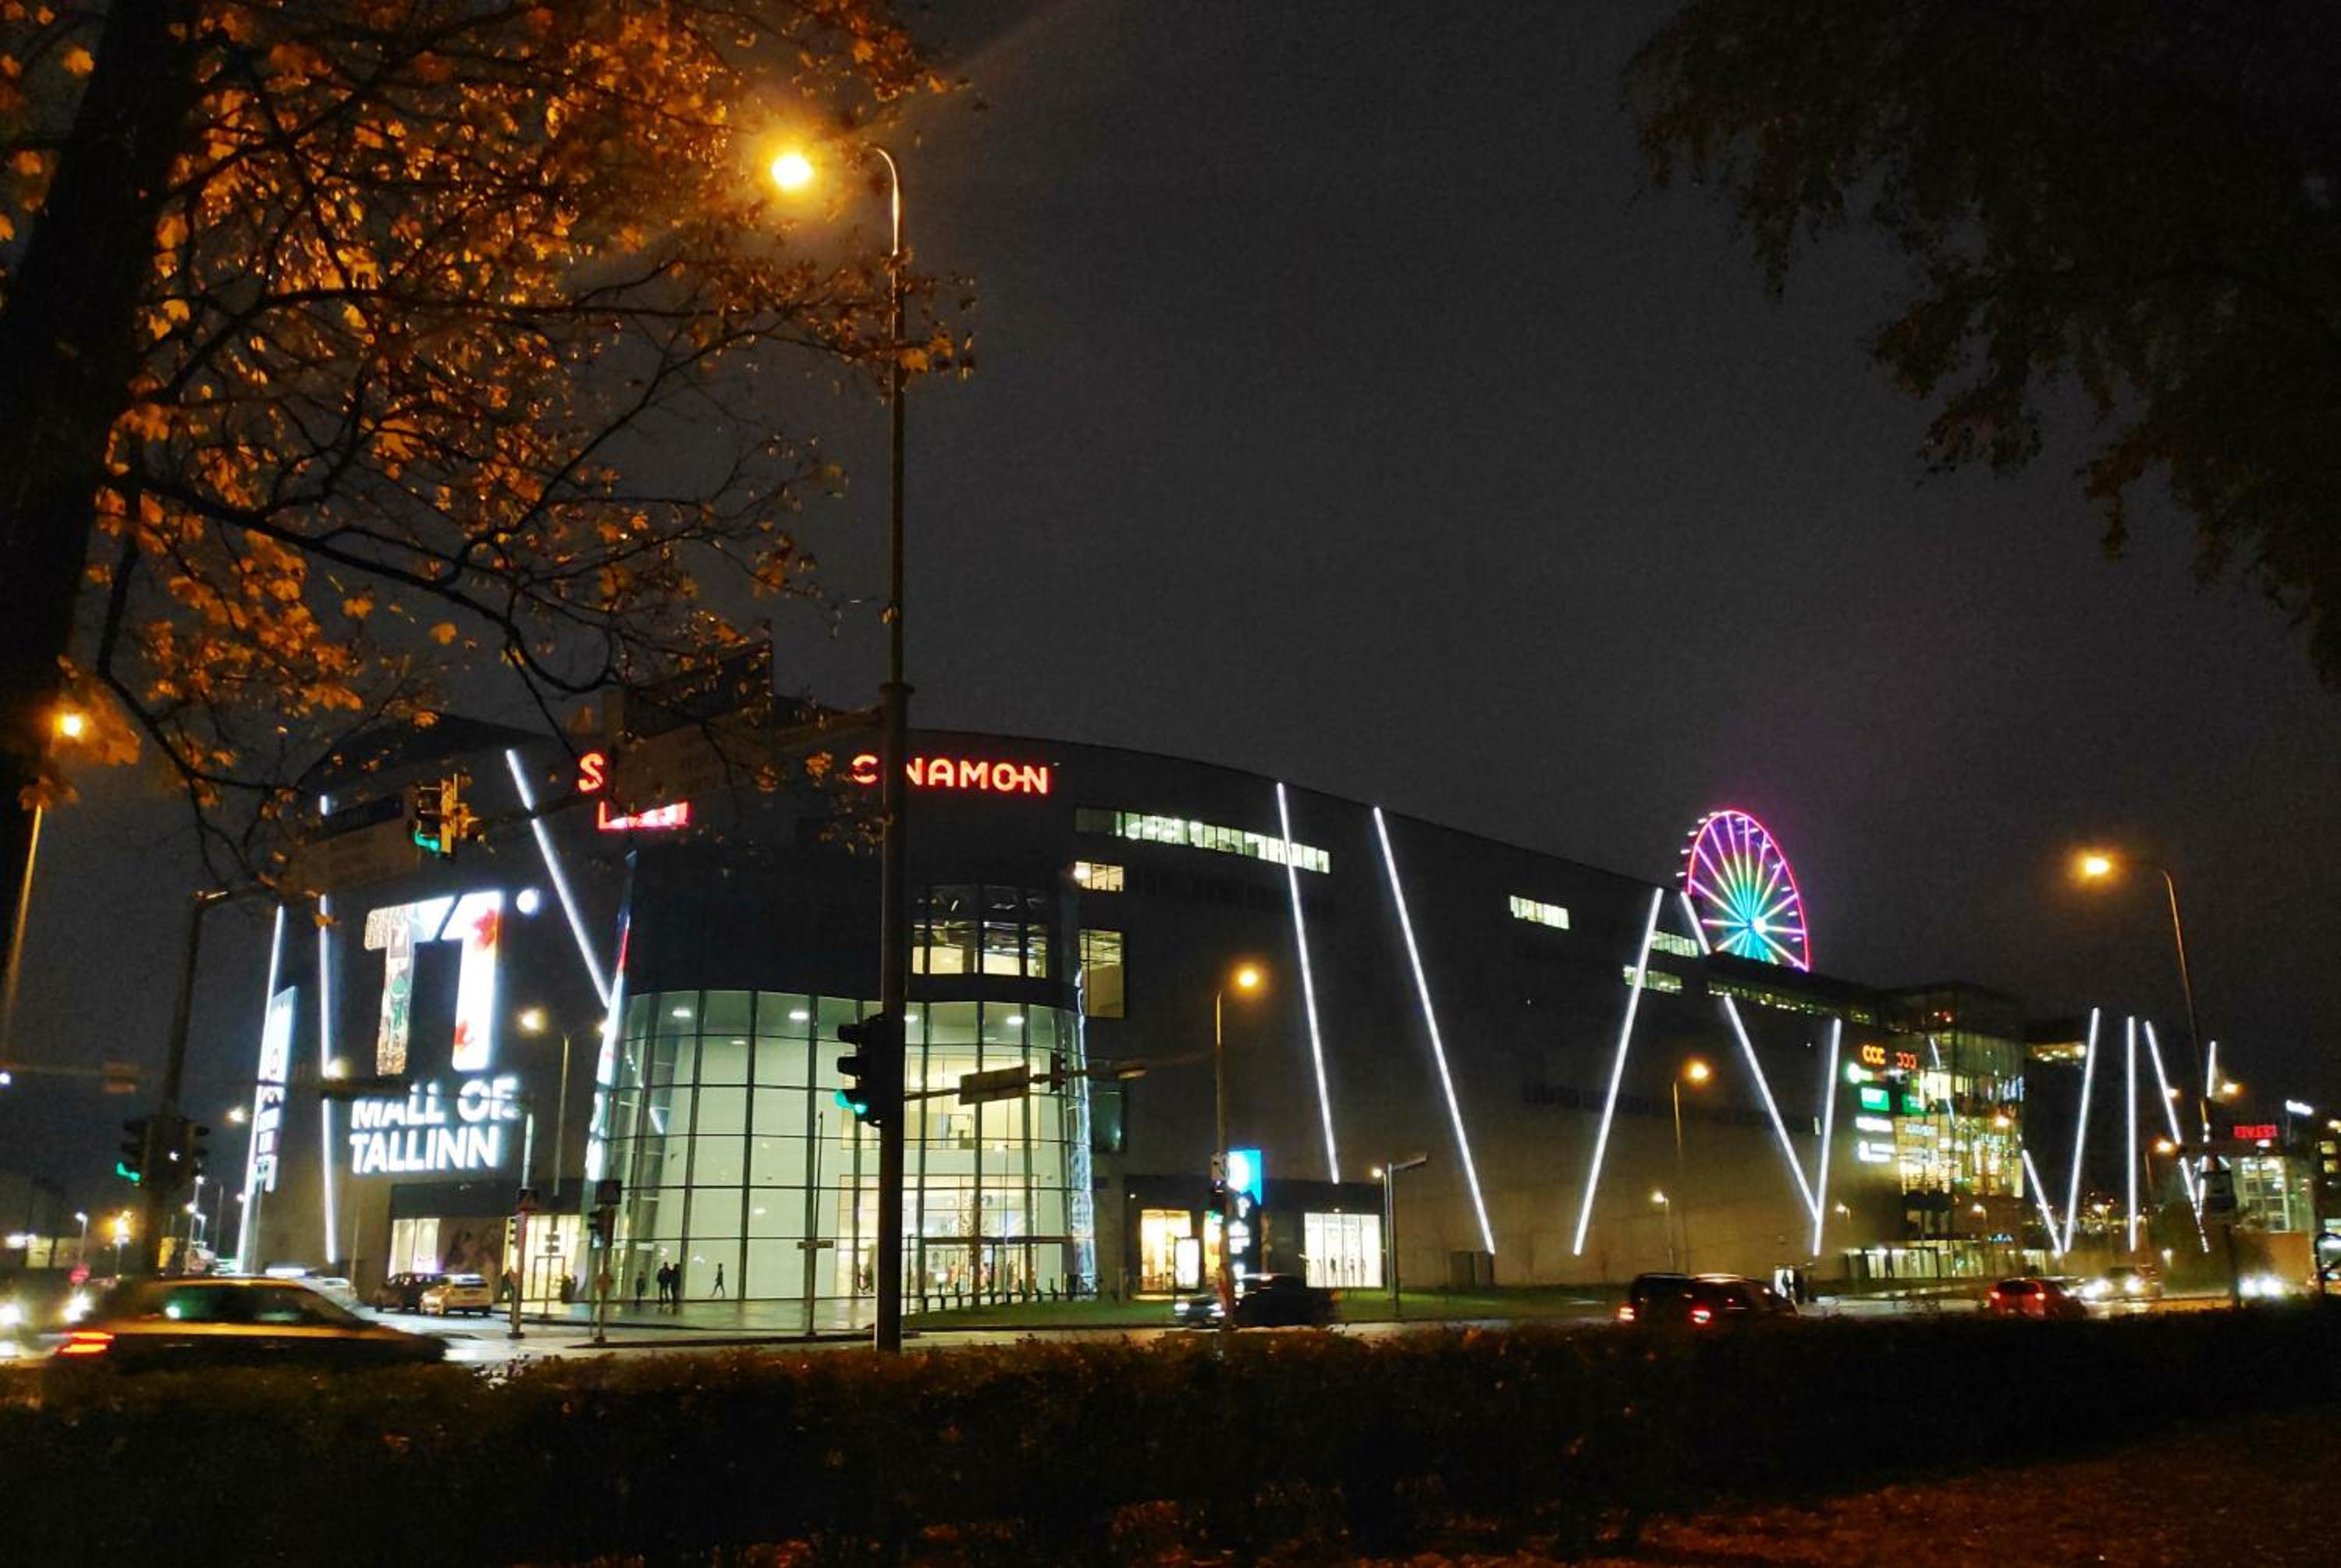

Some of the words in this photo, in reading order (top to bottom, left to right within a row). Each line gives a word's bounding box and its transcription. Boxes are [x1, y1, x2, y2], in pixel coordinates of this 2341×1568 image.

[851, 754, 1049, 795] CNAMON
[1863, 1044, 1886, 1065] CCC
[350, 1082, 446, 1130] MALL
[457, 1075, 521, 1123] OF
[350, 1124, 500, 1174] TALLINN
